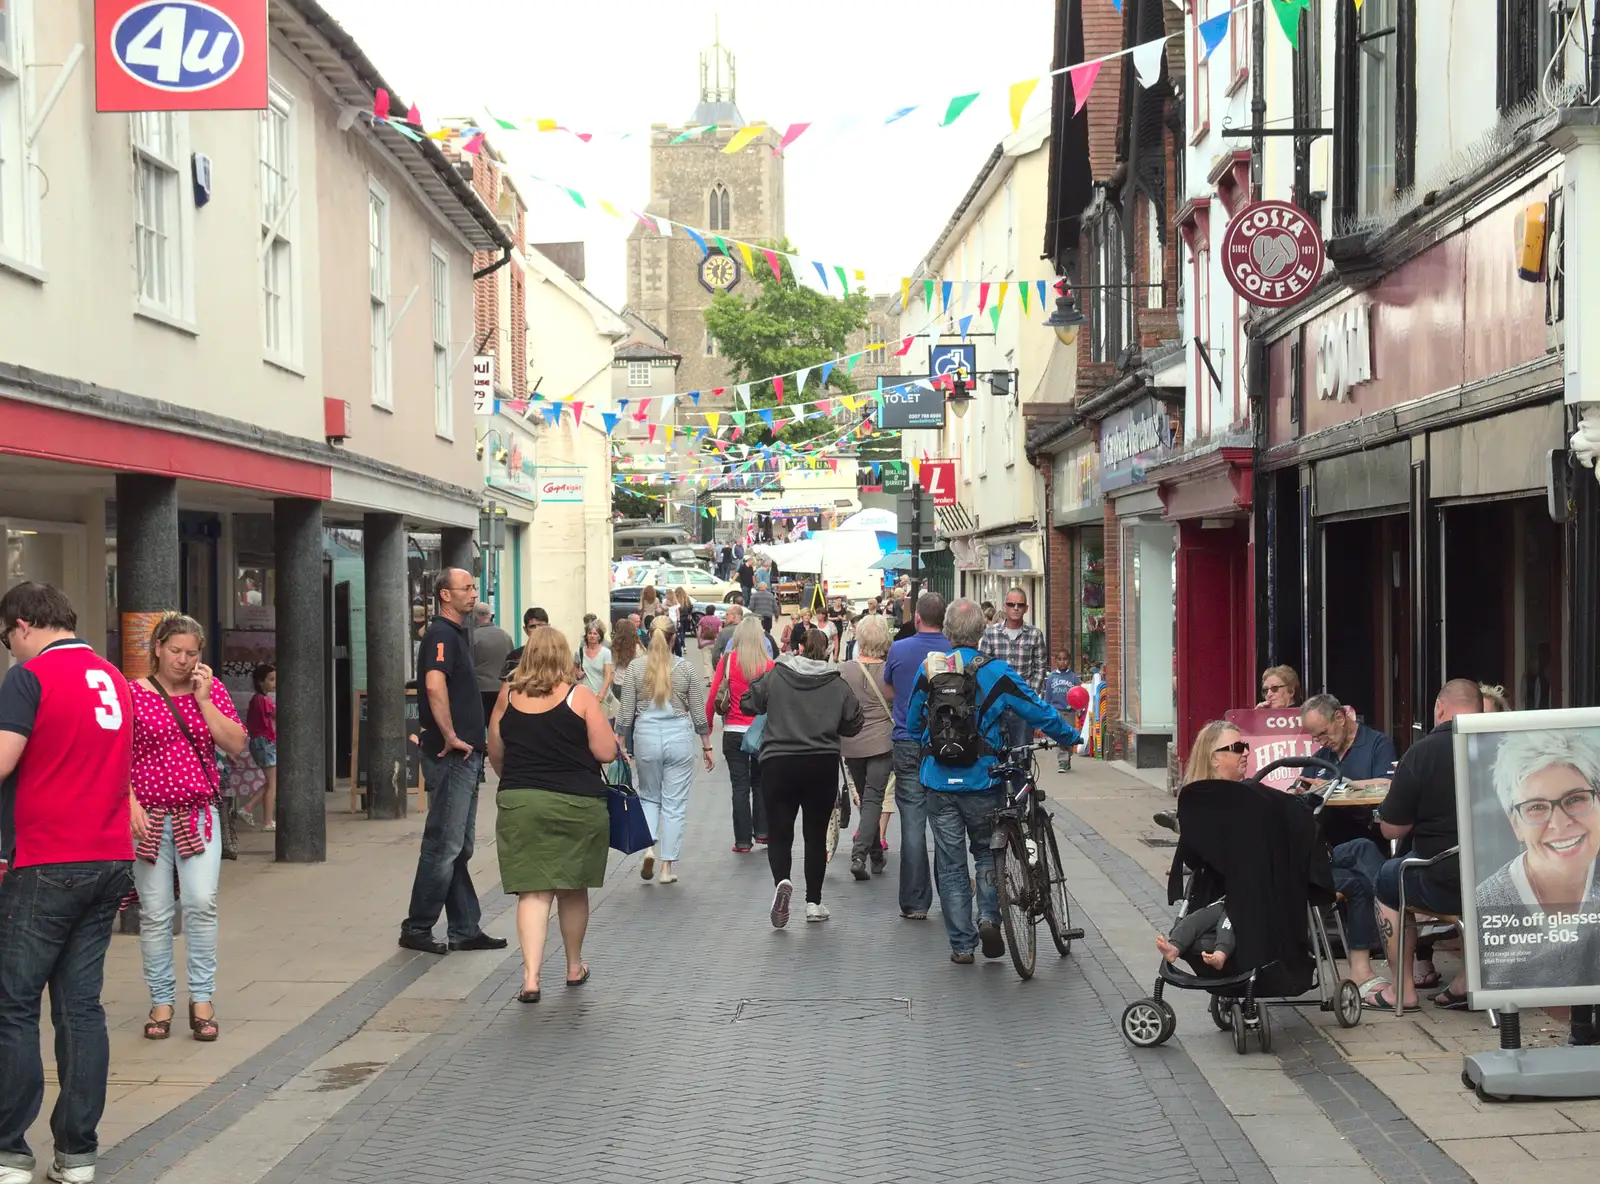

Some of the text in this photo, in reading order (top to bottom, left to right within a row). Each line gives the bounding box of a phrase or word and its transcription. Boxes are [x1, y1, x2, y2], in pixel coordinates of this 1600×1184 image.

[126, 6, 233, 82] 4u
[1241, 209, 1304, 238] COSTA
[1232, 244, 1248, 254] SINCE
[1302, 246, 1315, 255] 1971
[1236, 263, 1312, 298] COFFEE
[474, 402, 483, 411] 7
[884, 393, 921, 403] TO LET
[787, 461, 831, 469] MUSUM
[929, 467, 945, 494] L
[85, 669, 123, 730] 3
[1254, 740, 1323, 772] HELL
[1482, 914, 1519, 929] 25%
[1522, 913, 1544, 927] off
[1483, 928, 1579, 946] for over-60s
